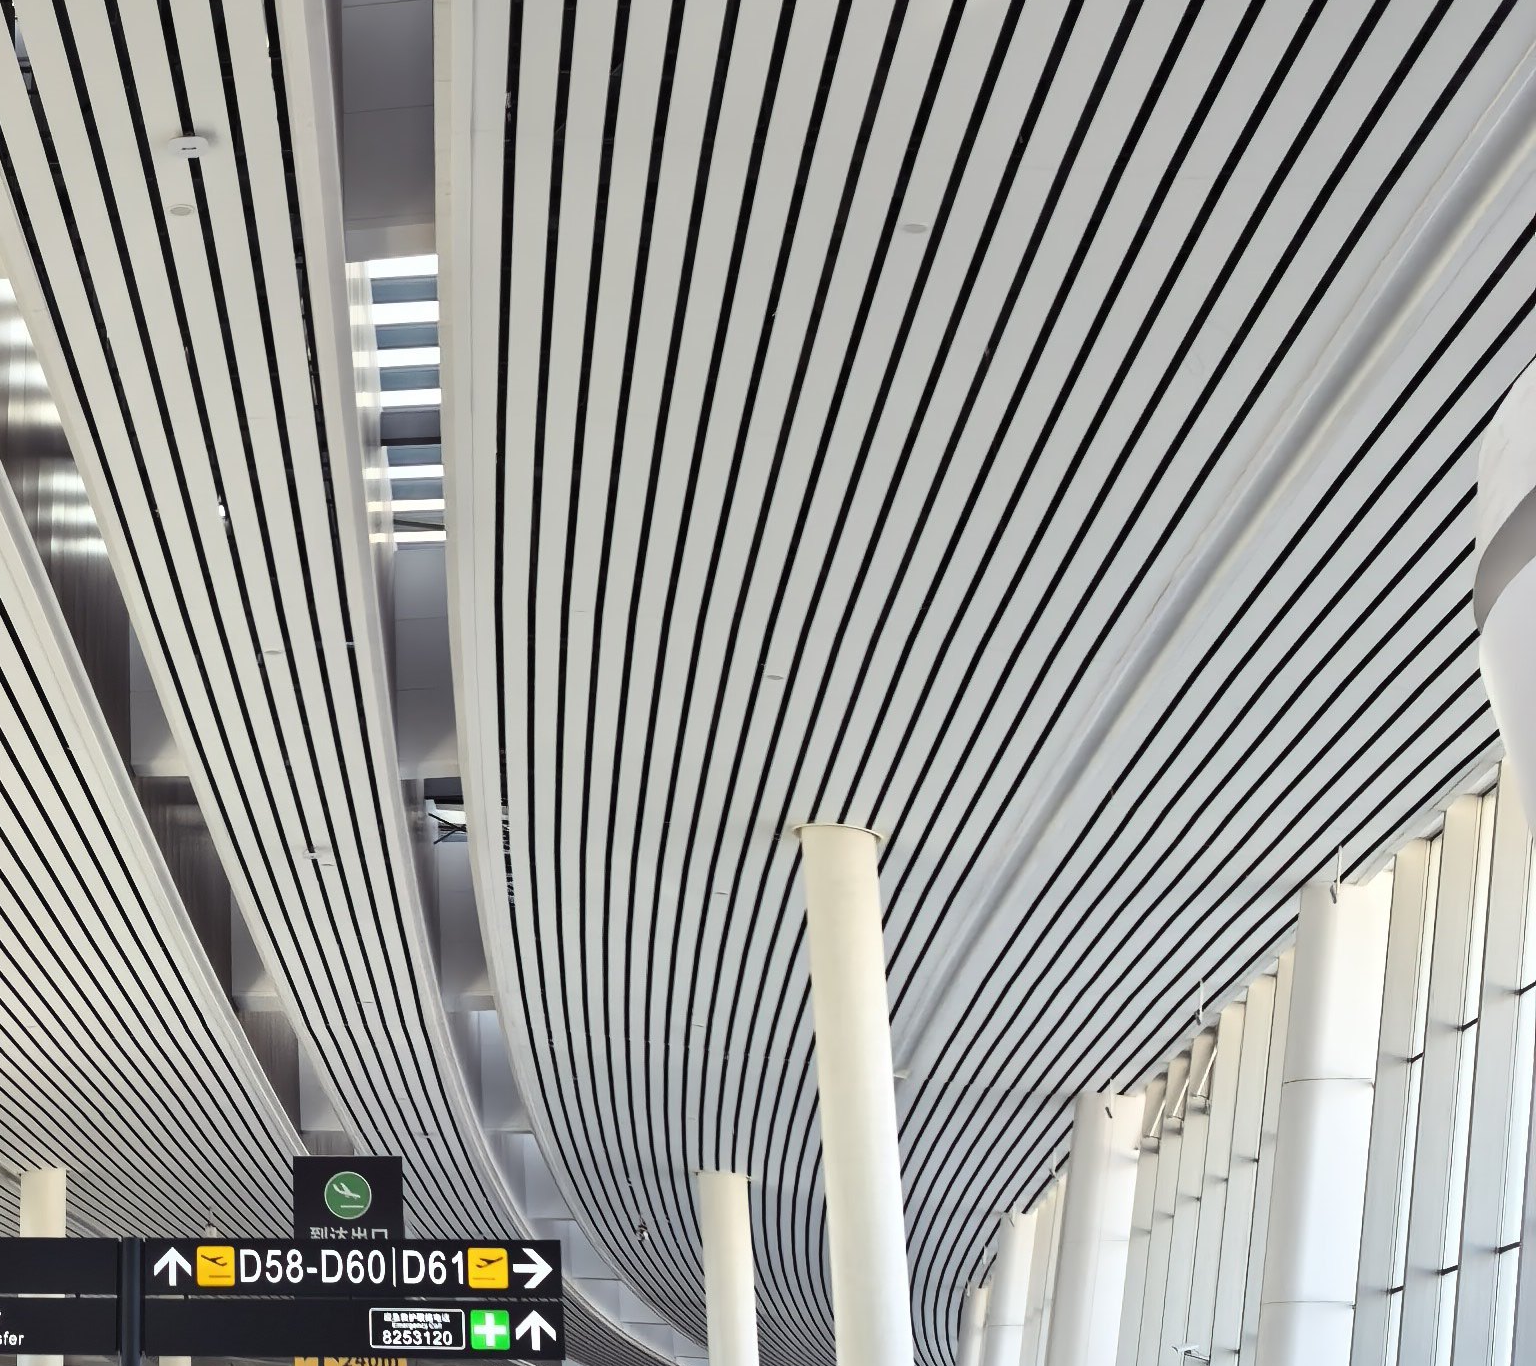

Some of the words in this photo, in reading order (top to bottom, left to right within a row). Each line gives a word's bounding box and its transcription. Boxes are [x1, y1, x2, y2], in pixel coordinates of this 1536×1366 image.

[239, 1248, 386, 1284] D58-D60
[401, 1249, 464, 1285] D61
[382, 1329, 453, 1346] 8253120
